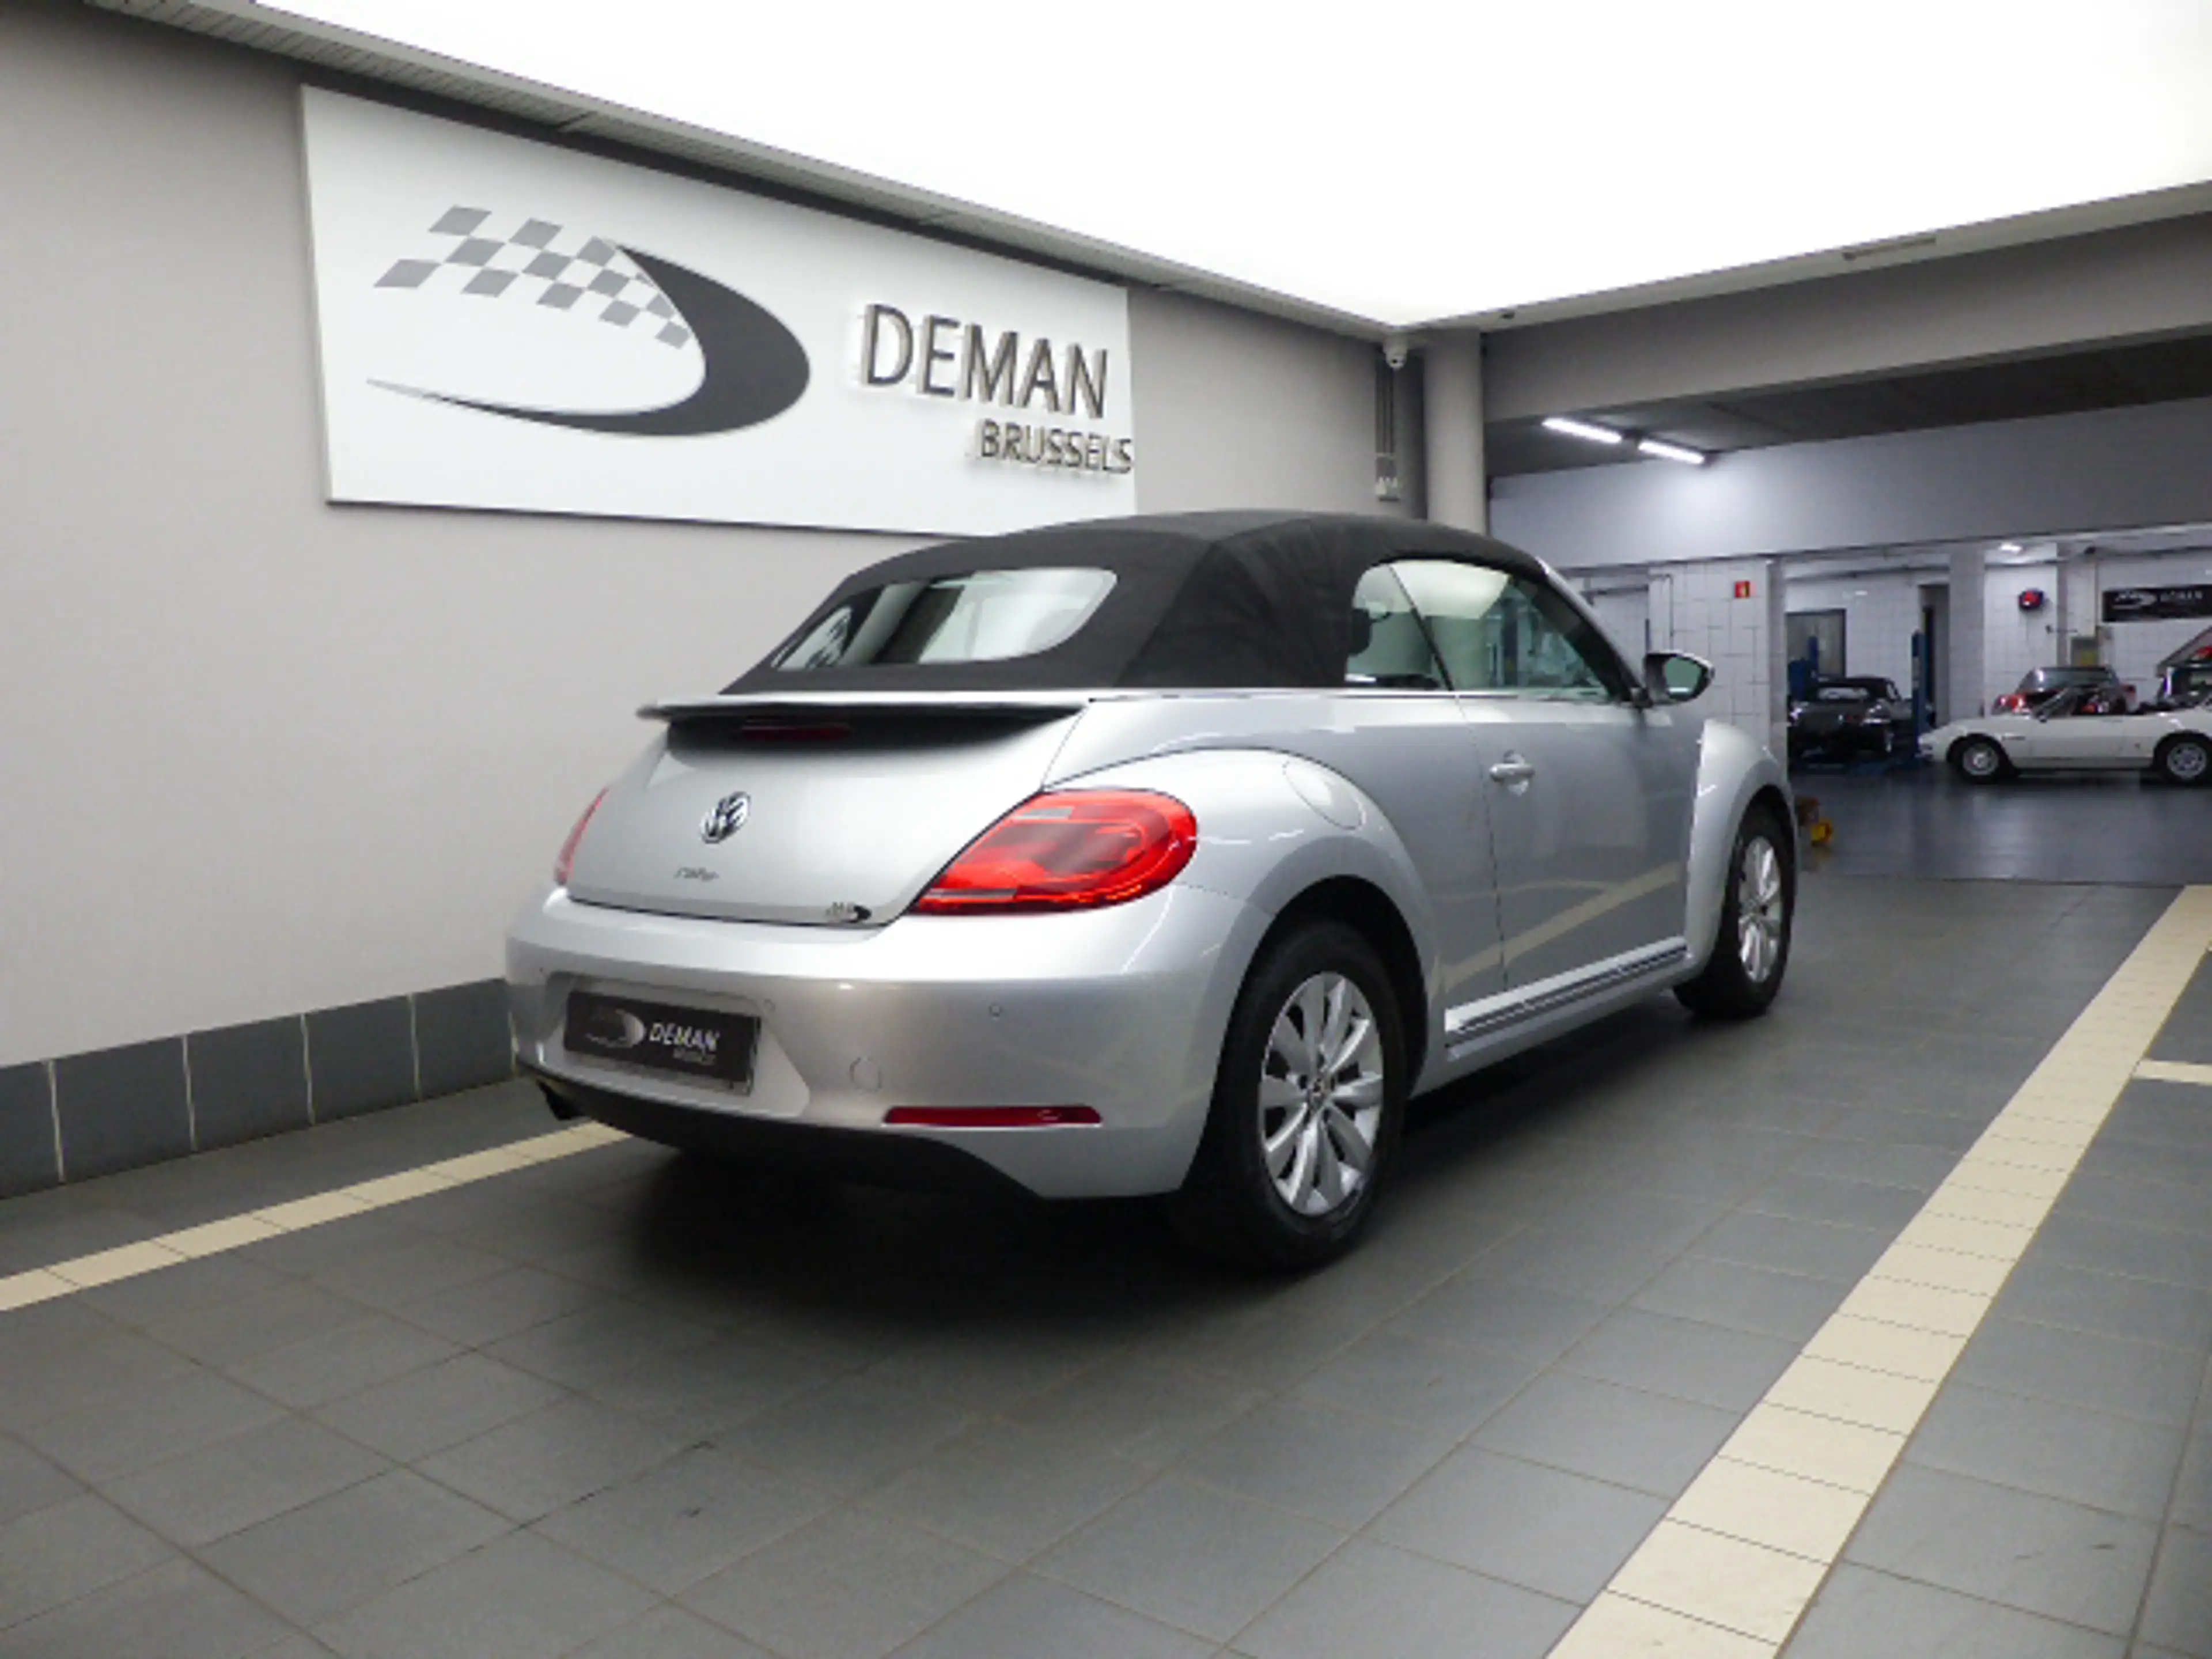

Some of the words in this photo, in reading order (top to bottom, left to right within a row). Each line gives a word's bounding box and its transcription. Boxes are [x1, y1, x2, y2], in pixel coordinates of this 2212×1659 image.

[862, 303, 1107, 418] DEMAN
[978, 418, 1132, 474] BRUSSELS
[649, 1022, 720, 1052] DEMAN
